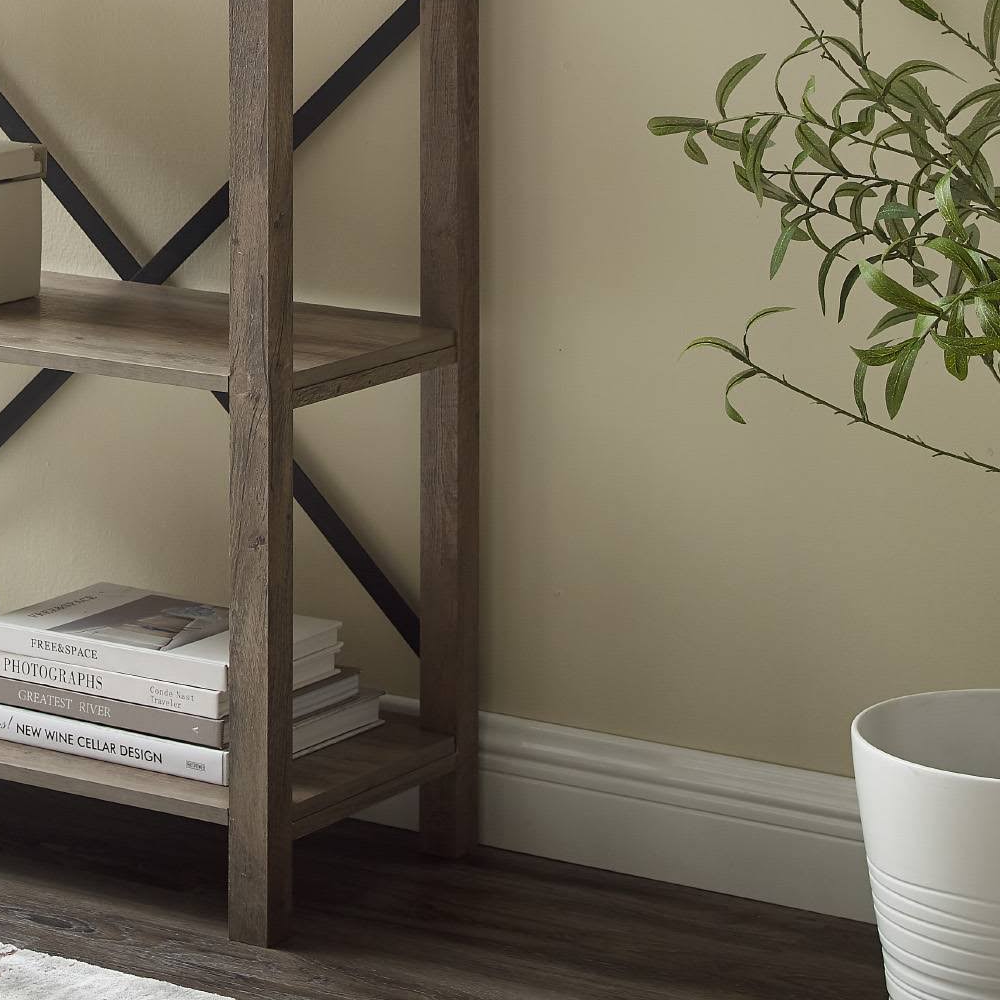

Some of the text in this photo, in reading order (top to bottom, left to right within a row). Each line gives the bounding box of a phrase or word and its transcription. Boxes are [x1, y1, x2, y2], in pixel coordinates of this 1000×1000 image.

[31, 638, 98, 660] FREE&SPACE
[4, 657, 103, 690] PHOTOGRAPHS
[18, 689, 111, 718] GREATEST RIVER
[149, 685, 173, 698] Conde
[151, 695, 181, 709] Traveler
[16, 723, 42, 738] NEW
[44, 728, 74, 746] WINE
[77, 736, 116, 754] CELLAR
[119, 744, 163, 764] DESIGN
